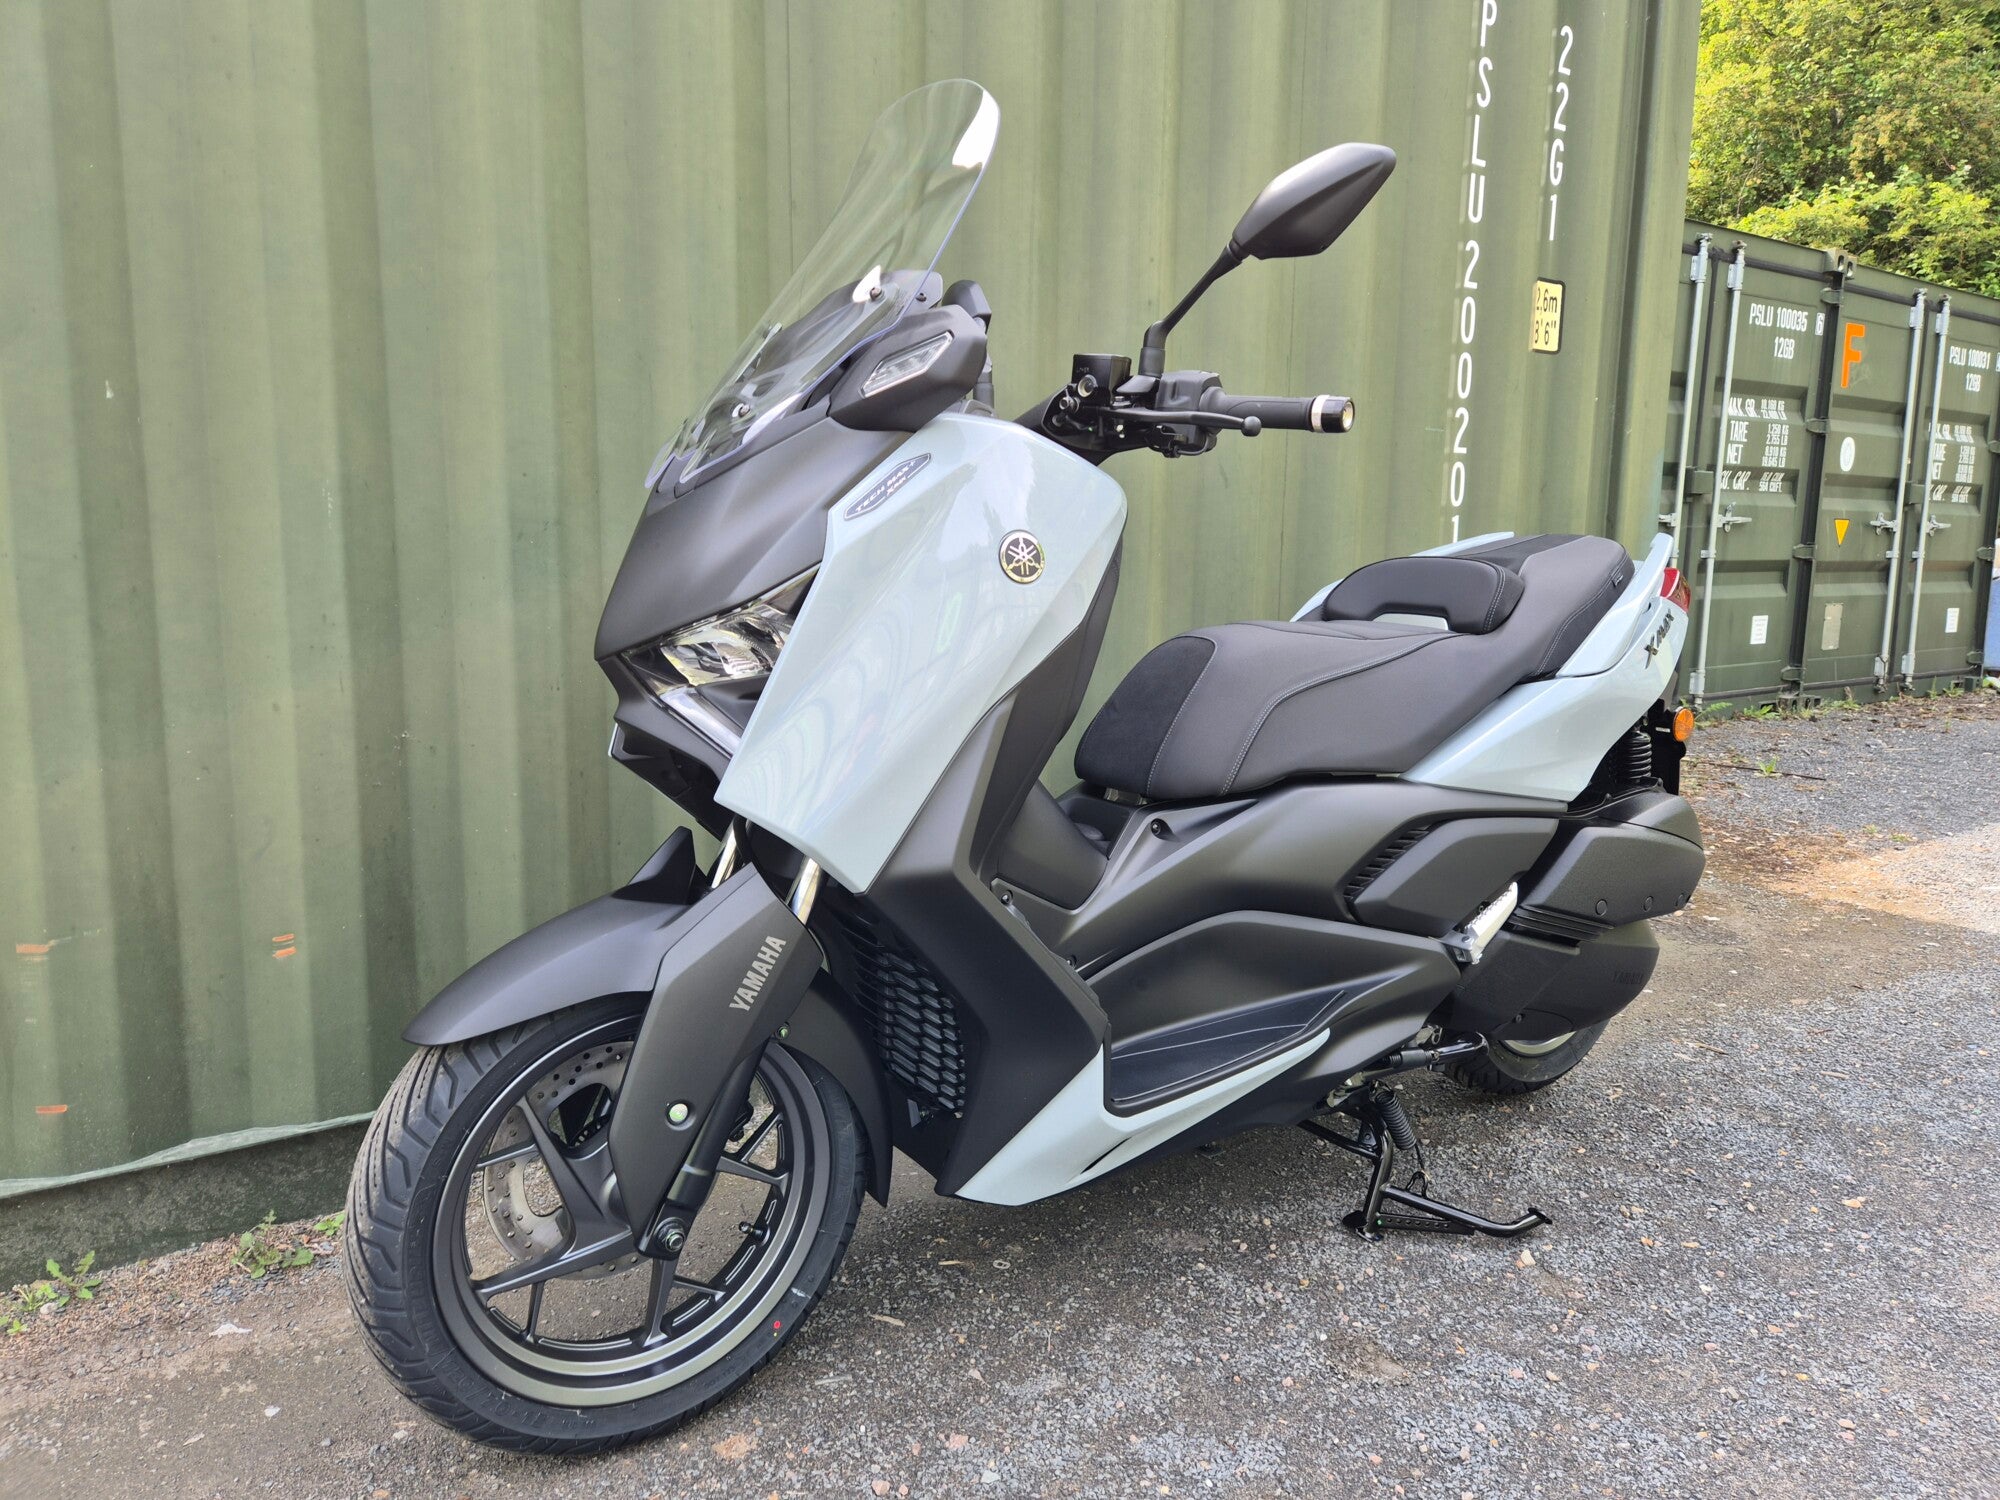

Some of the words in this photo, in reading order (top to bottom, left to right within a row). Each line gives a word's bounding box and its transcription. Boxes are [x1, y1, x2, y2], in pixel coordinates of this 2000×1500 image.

[1468, 0, 1498, 223] PSLU
[1550, 25, 1574, 241] 22G1
[1749, 303, 1774, 327] PSLU
[1776, 307, 1808, 332] 100035
[1774, 336, 1795, 360] 12GB
[1841, 322, 1866, 389] F
[1450, 240, 1480, 543] 200201
[1726, 443, 1744, 464] NET
[1730, 420, 1749, 442] TARE
[728, 935, 787, 1011] YAMAHA
